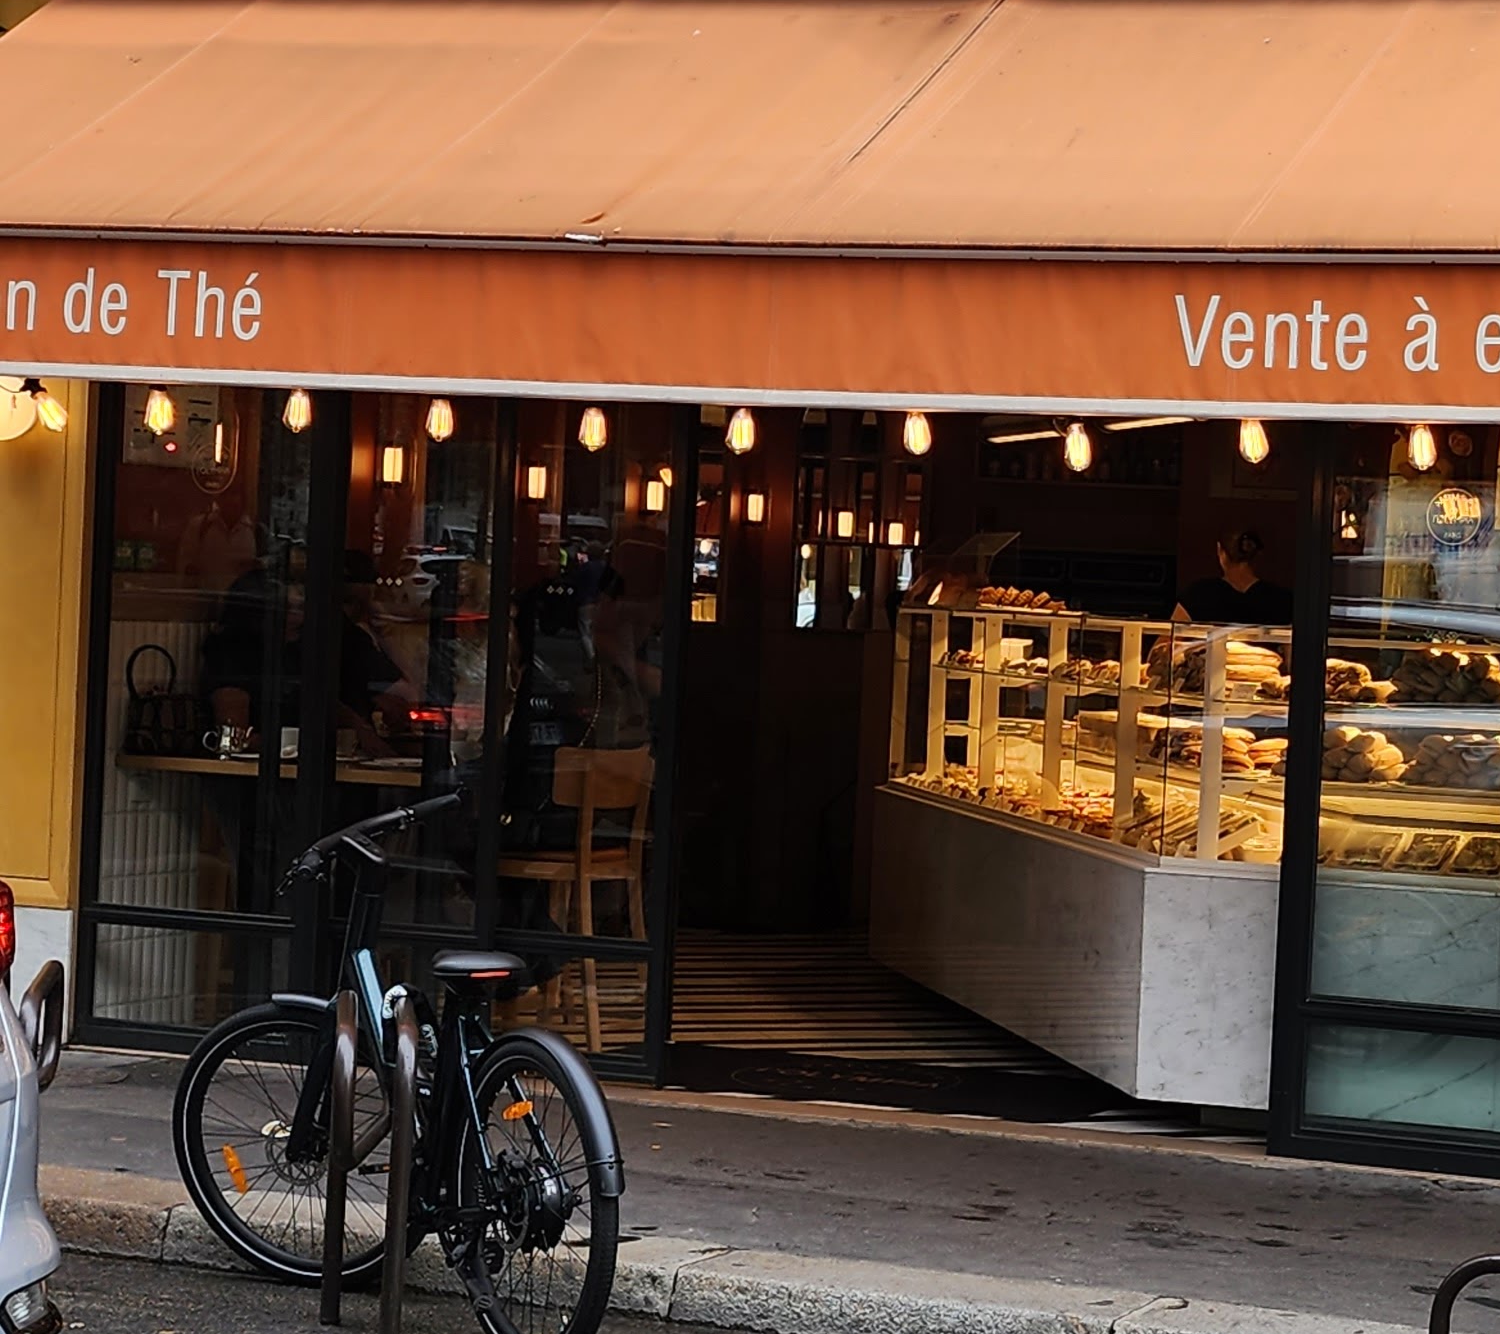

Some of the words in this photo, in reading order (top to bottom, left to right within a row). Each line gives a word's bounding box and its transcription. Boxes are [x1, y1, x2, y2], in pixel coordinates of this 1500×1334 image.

[63, 267, 128, 335] de
[157, 270, 262, 341] Thé
[1174, 294, 1368, 370] Vente
[1403, 295, 1440, 372] à
